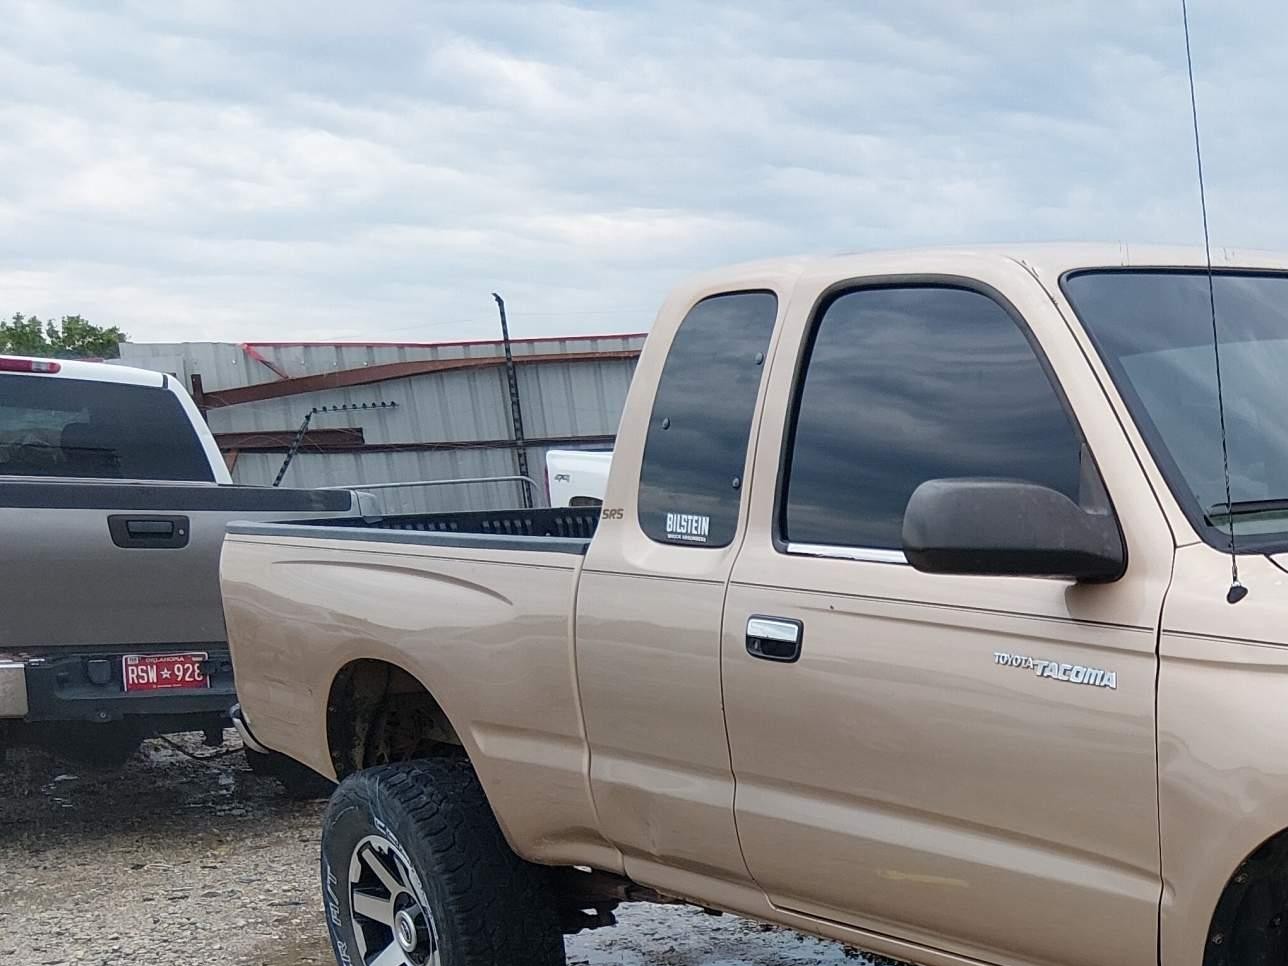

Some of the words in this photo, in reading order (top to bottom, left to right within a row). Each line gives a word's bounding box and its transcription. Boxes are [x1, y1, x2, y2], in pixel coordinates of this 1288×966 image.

[665, 512, 710, 536] BILSTEIN
[127, 664, 158, 685] RSW
[993, 652, 1034, 669] TOYOTA
[1034, 660, 1118, 690] TACOMA
